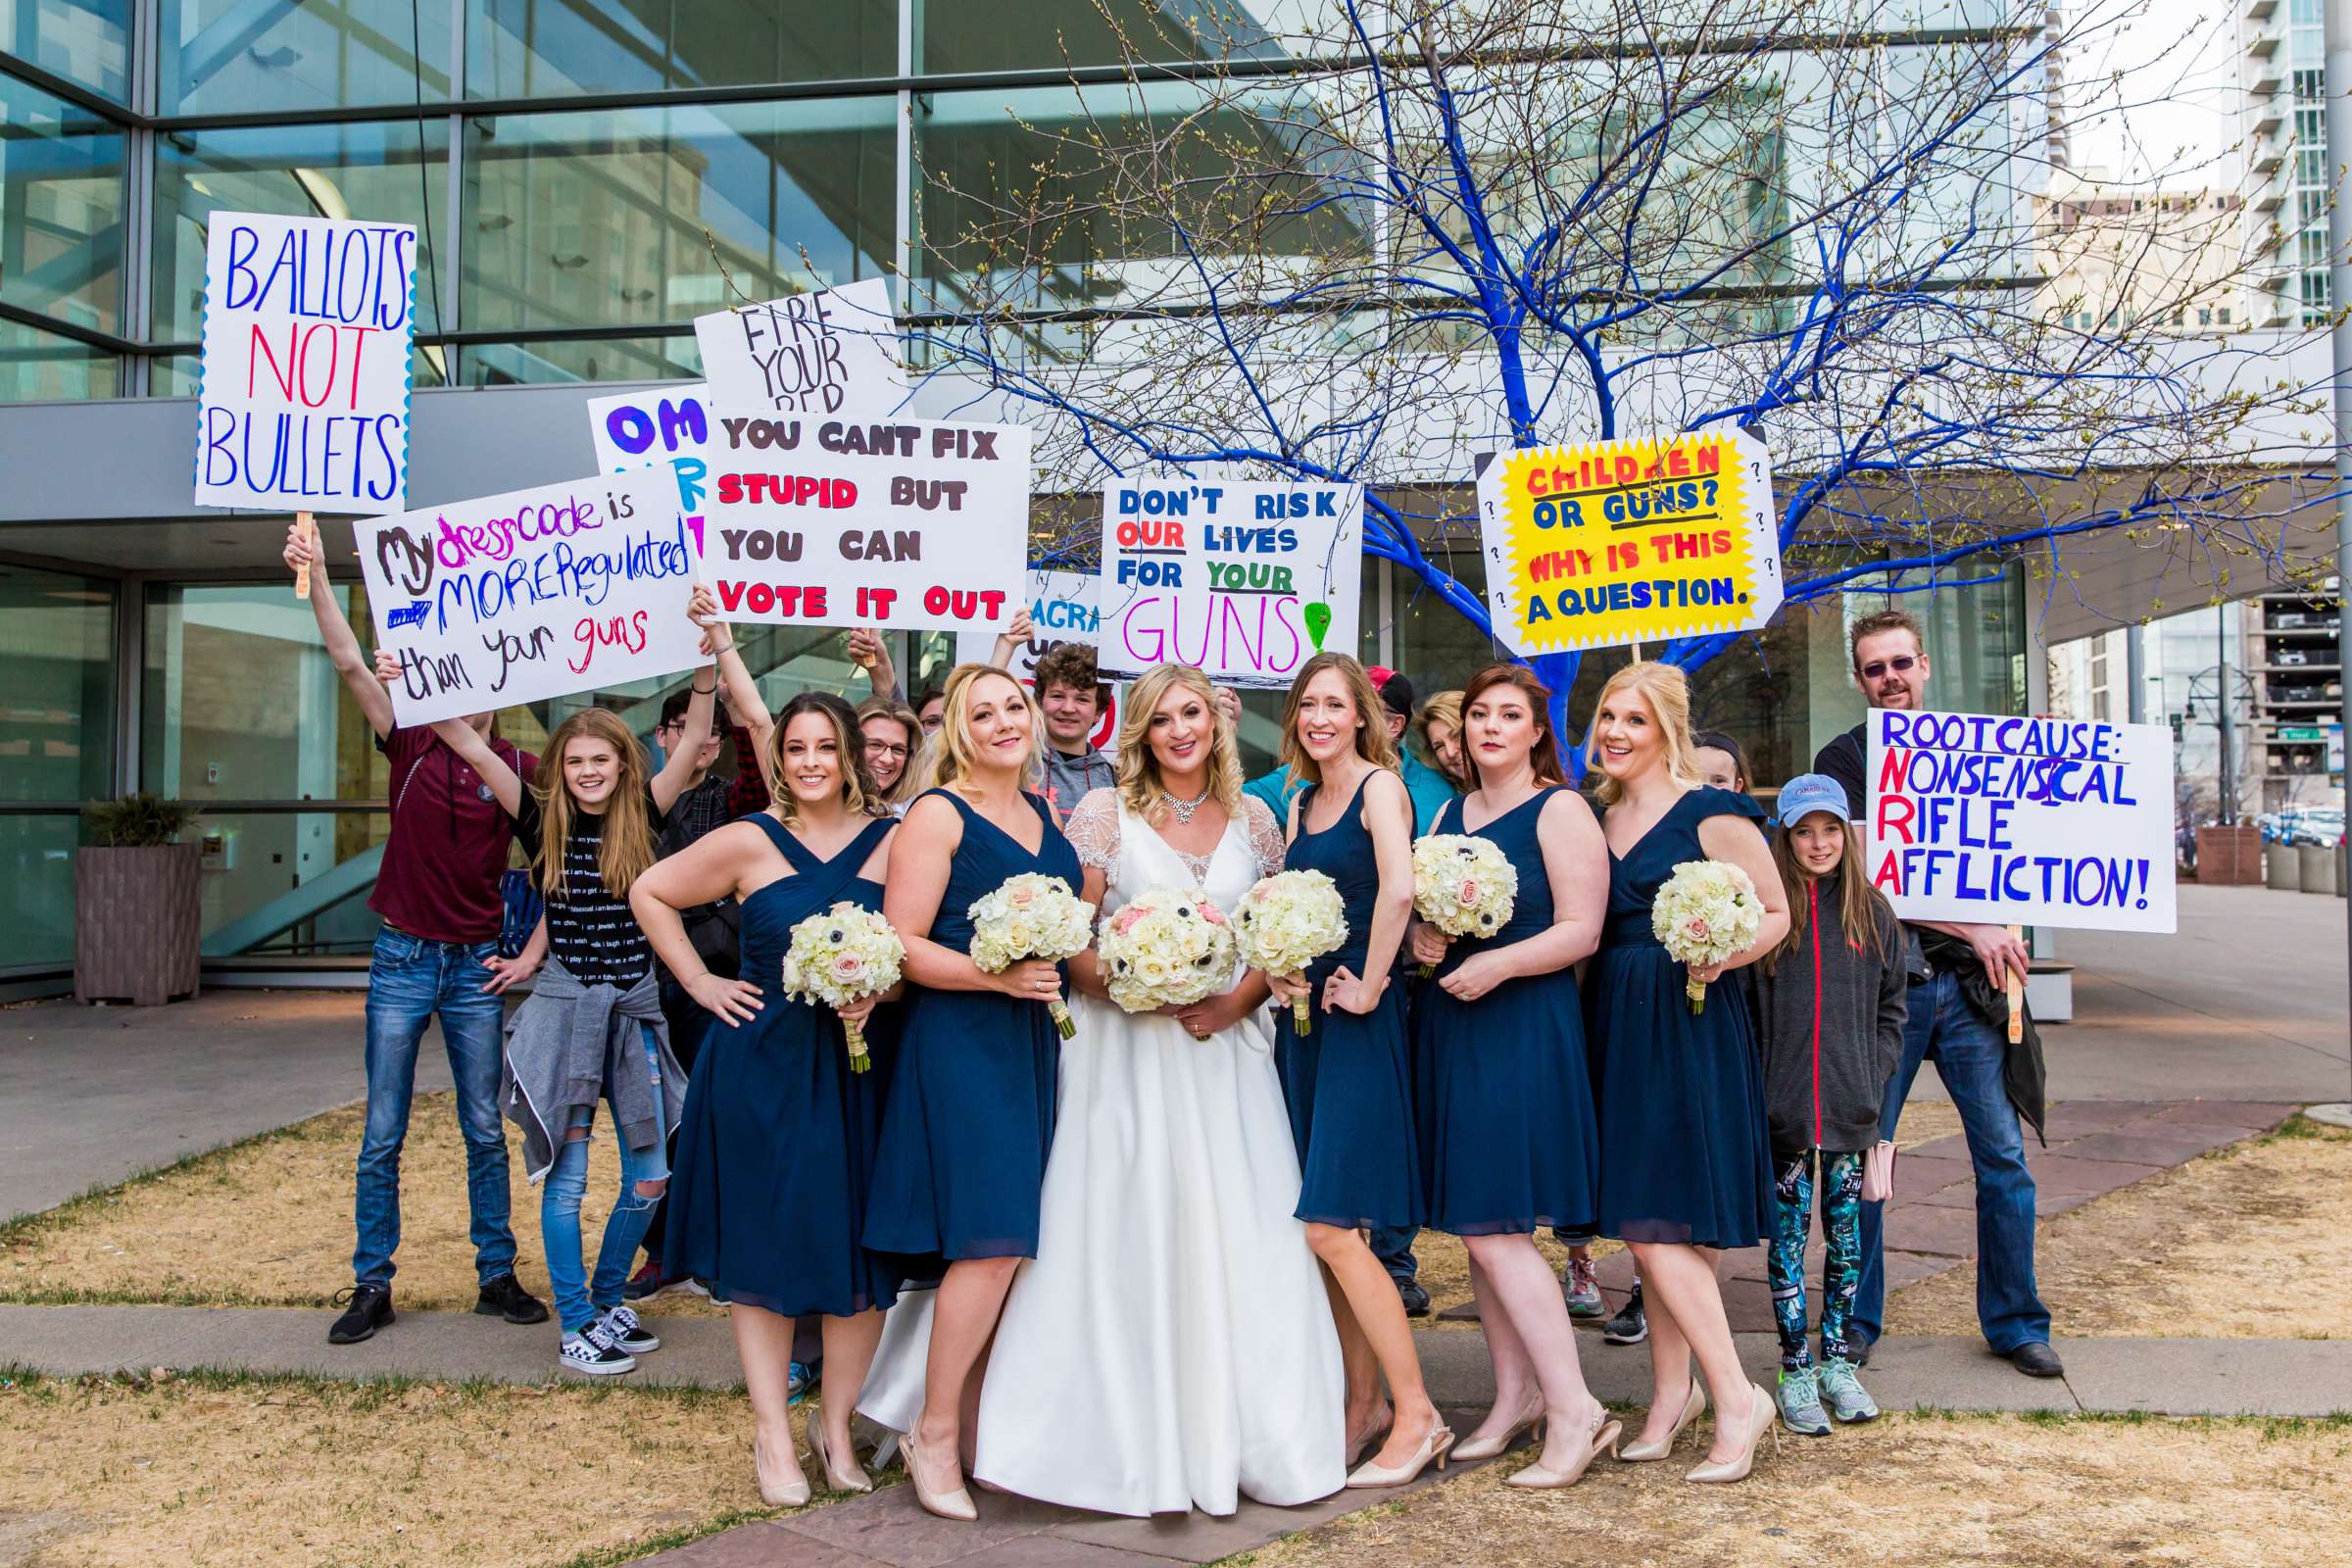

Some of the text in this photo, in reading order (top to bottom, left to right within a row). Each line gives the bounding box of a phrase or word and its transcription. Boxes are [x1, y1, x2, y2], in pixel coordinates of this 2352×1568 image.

[225, 226, 416, 330] BALLOTS
[743, 289, 836, 352] FIRE
[249, 322, 380, 411] NOT
[752, 337, 848, 398] YOUR
[205, 407, 401, 502] BULLETS
[721, 418, 1000, 461] YOU CANT FIX
[717, 473, 858, 510] STUPID
[891, 475, 968, 512] BUT
[1527, 445, 1719, 497] CHILDREN
[608, 492, 634, 519] is
[1118, 485, 1337, 519] DON'T RISK
[1533, 479, 1719, 529] OR GUNS?
[721, 530, 804, 562] YOU
[838, 530, 921, 562] CAN
[1116, 520, 1298, 553] OUR LIVES
[1529, 529, 1732, 584] WHY IS THIS
[439, 552, 559, 635] MORE
[717, 580, 1005, 620] VOTE IT OUT
[1118, 560, 1294, 591] FOR YOUR
[1527, 577, 1748, 624] A QUESTION.
[399, 610, 647, 701] than your guns
[1878, 795, 2015, 850] RIFLE
[1875, 849, 2150, 910] AFFLICTION!
